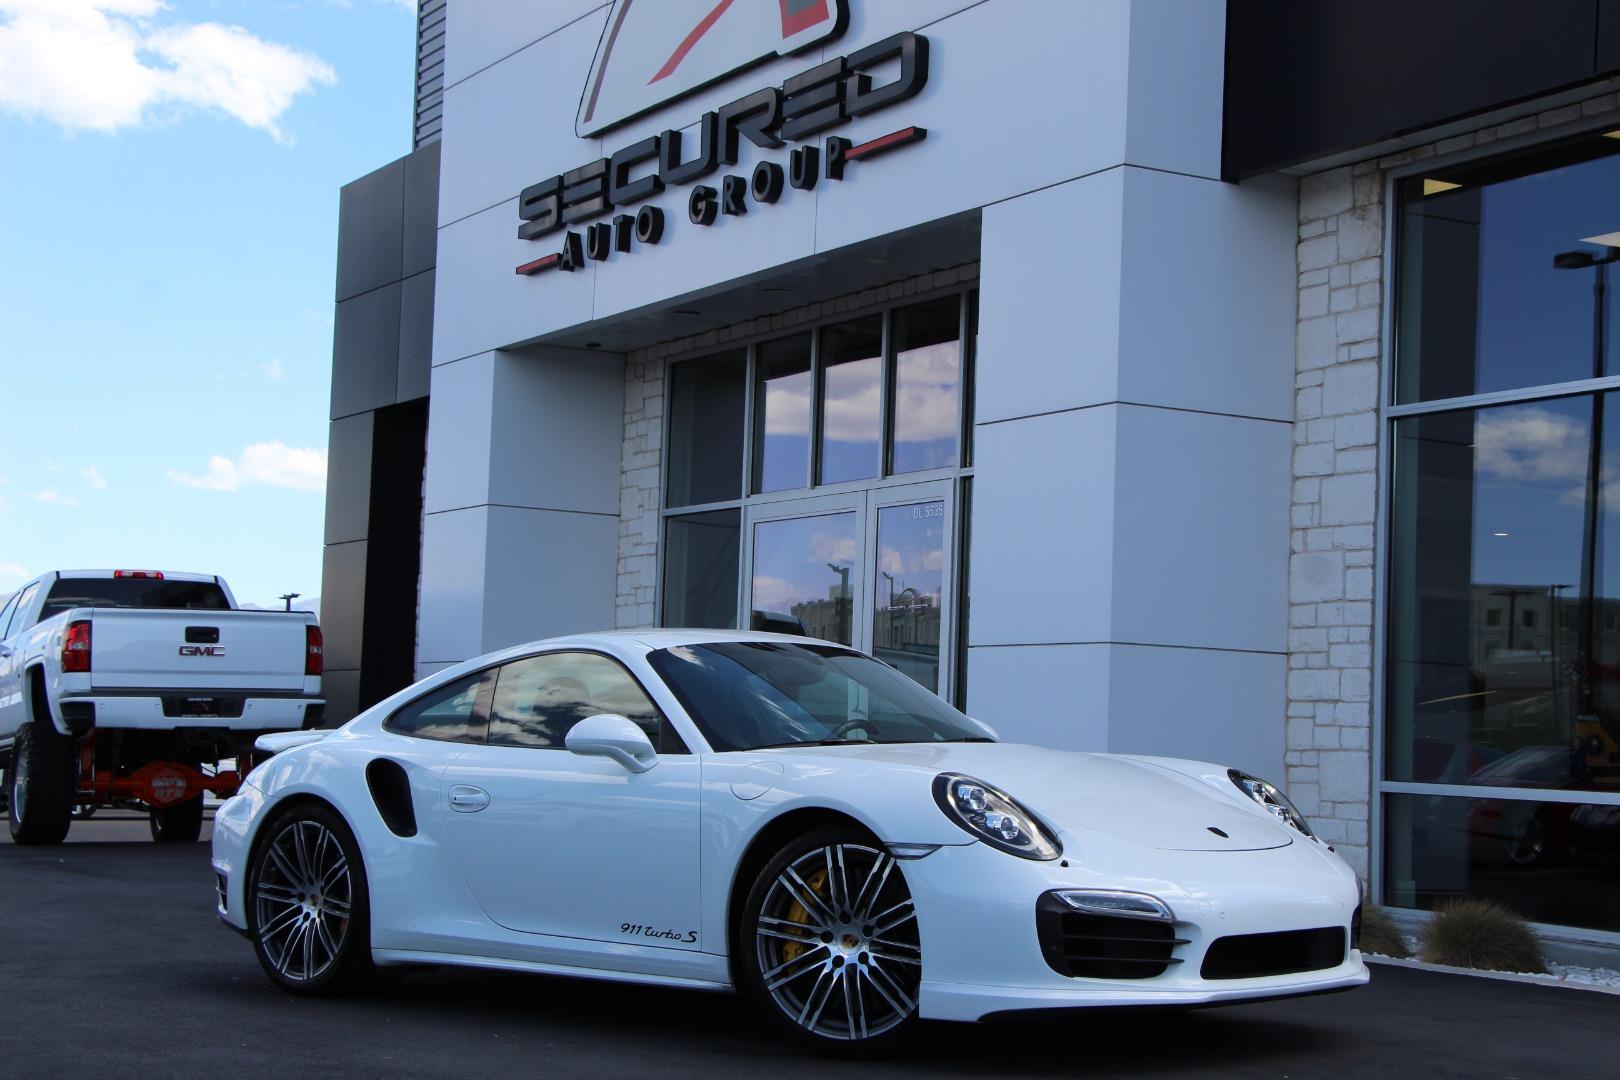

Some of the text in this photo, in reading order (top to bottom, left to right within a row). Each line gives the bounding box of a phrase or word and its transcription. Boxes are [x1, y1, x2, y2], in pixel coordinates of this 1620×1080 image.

[518, 31, 930, 240] SECURED
[559, 135, 853, 272] AUTO GROUP
[913, 506, 924, 519] DL
[178, 645, 226, 657] GMC
[620, 922, 642, 935] 911
[681, 930, 698, 943] S
